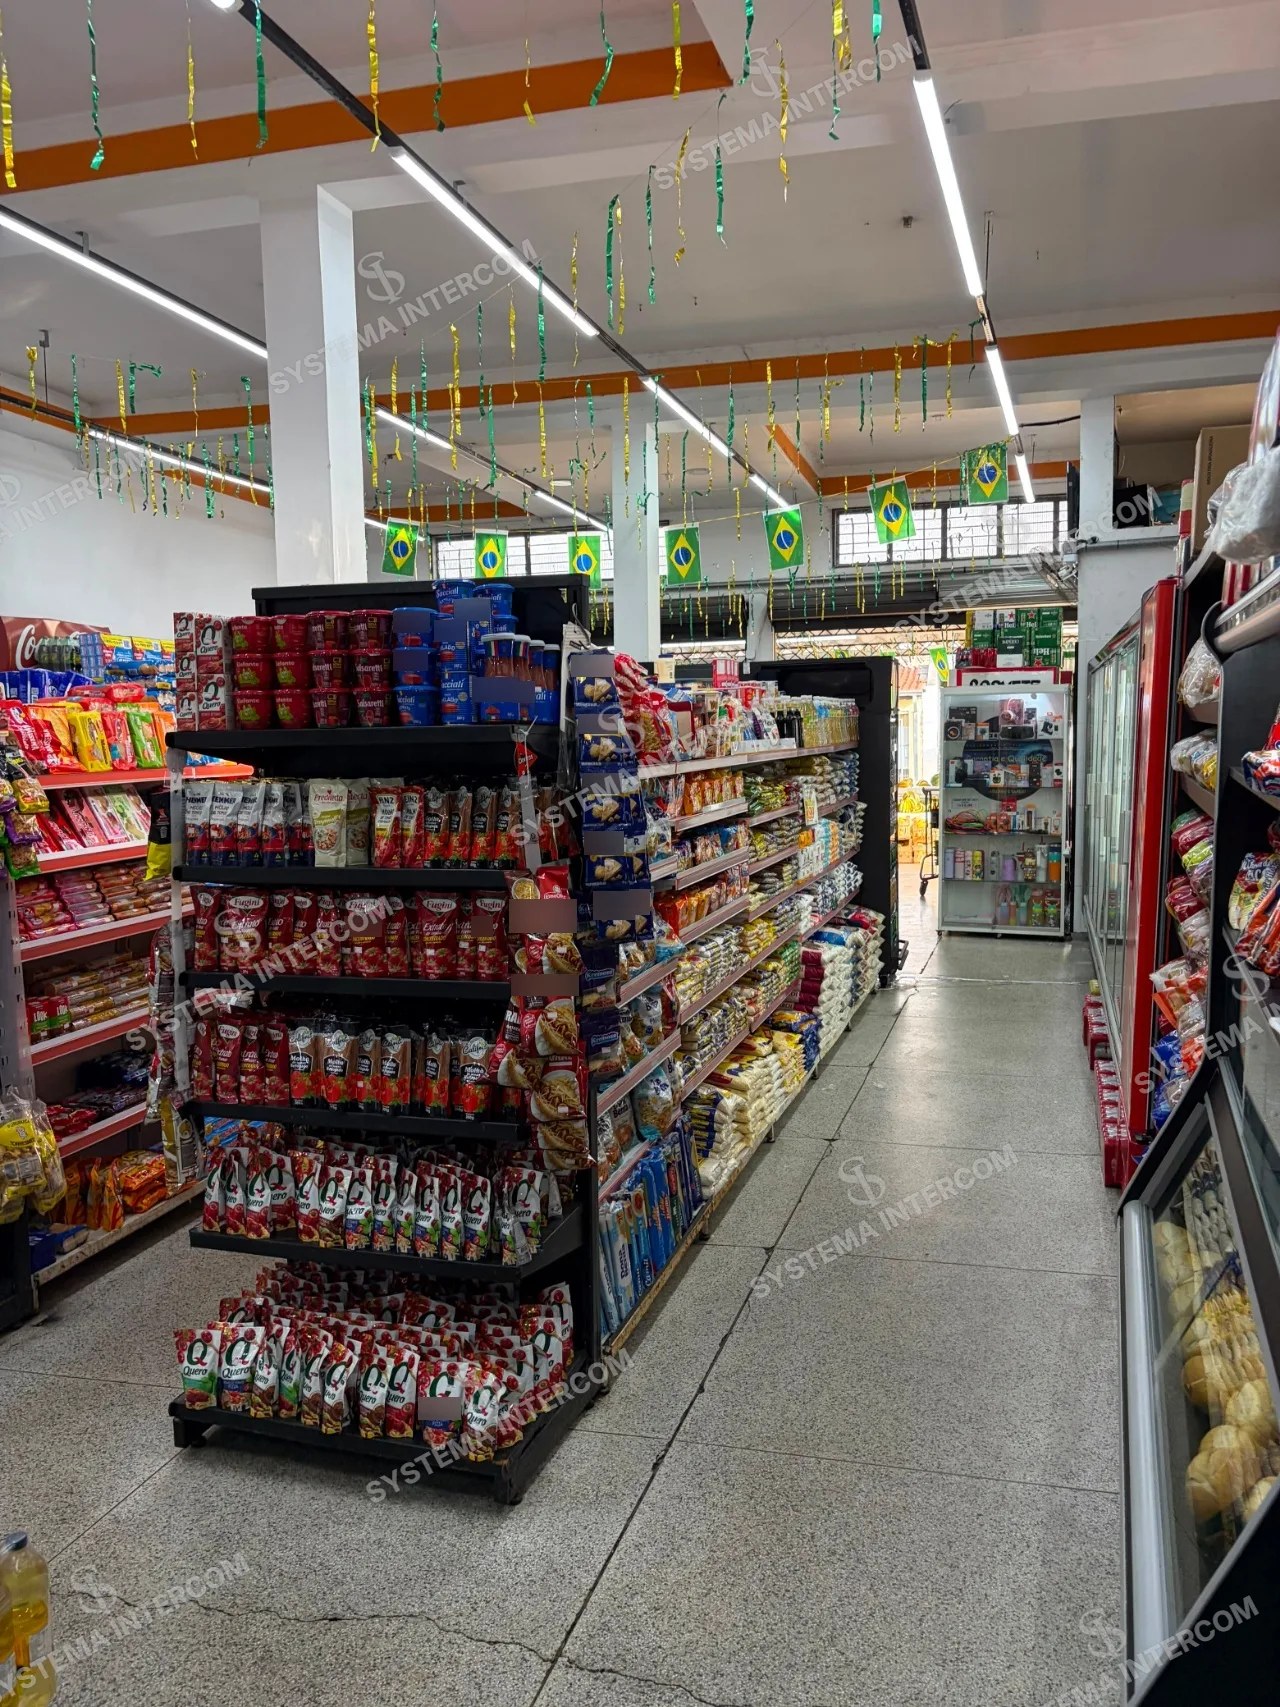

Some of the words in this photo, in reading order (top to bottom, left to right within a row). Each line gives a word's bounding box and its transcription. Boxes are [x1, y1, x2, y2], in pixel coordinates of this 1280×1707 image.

[202, 701, 221, 710] Quero
[234, 898, 260, 907] Fugini
[426, 901, 453, 912] Fugini
[186, 1338, 208, 1367] Q
[183, 1366, 208, 1378] Quero
[222, 1366, 250, 1378] Quero
